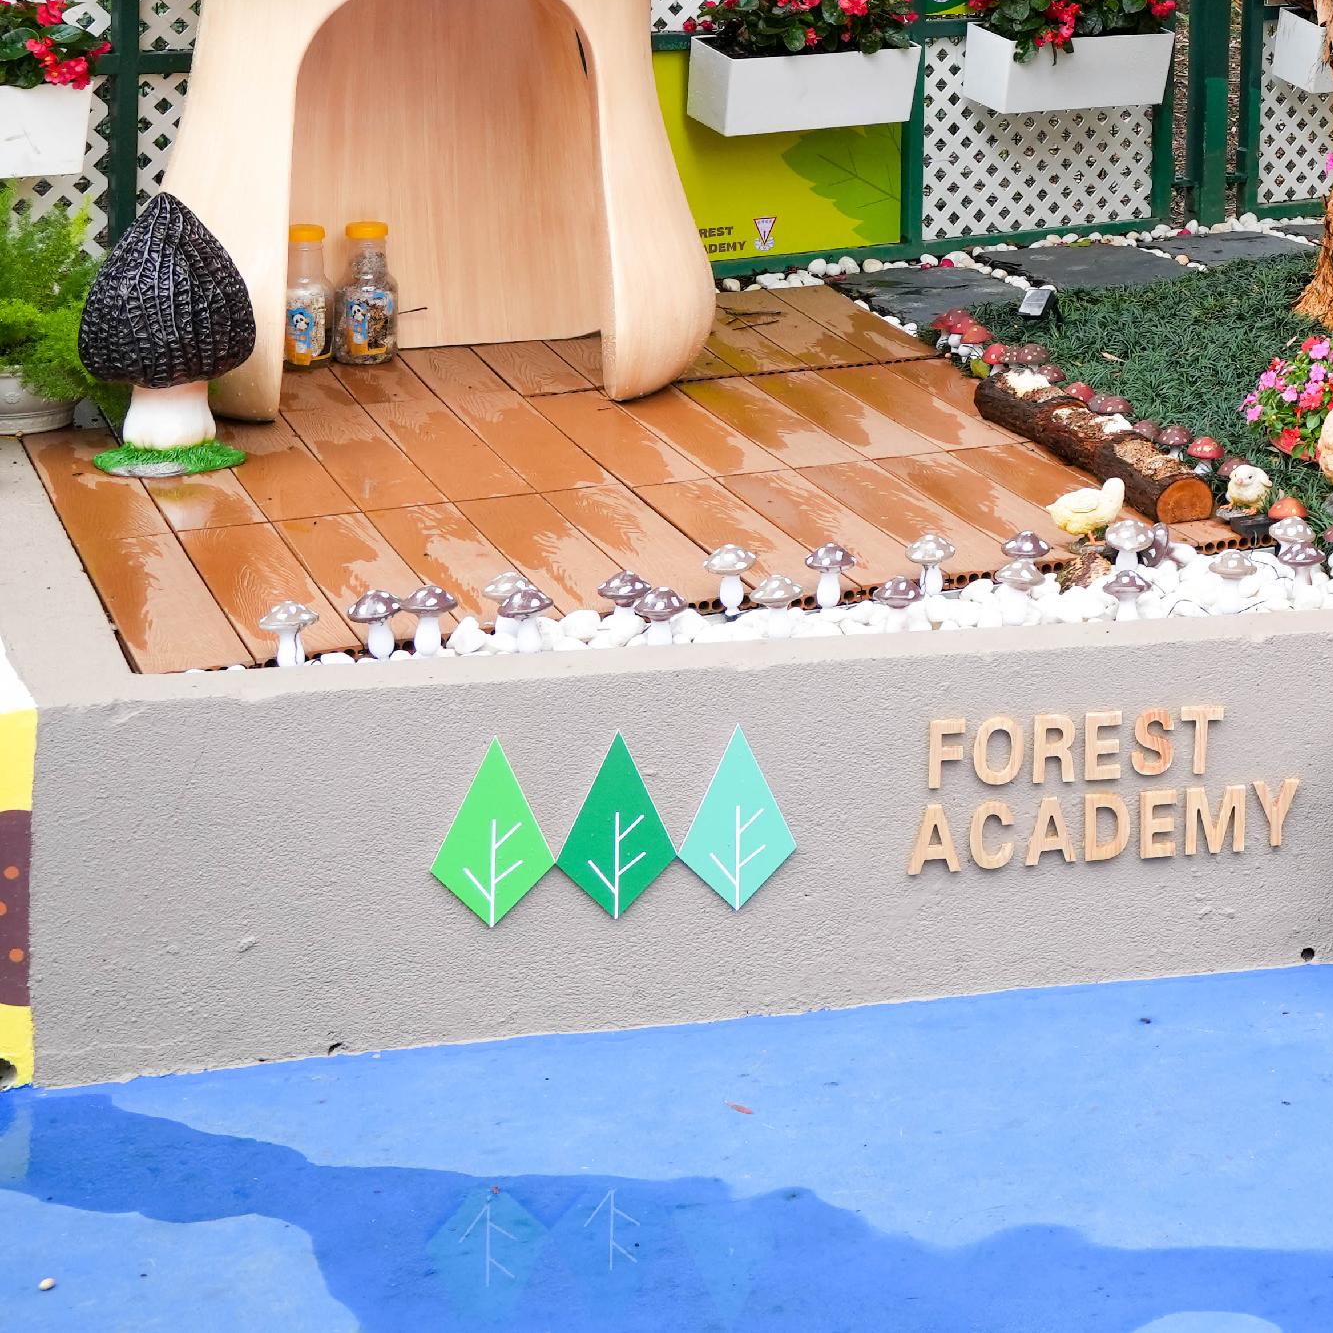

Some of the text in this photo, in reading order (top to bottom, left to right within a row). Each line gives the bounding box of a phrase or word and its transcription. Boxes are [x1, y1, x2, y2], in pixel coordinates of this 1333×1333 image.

[698, 226, 734, 239] REST
[704, 240, 747, 254] DEMY
[927, 704, 1225, 791] FOREST
[906, 777, 1301, 876] ACADEMY
